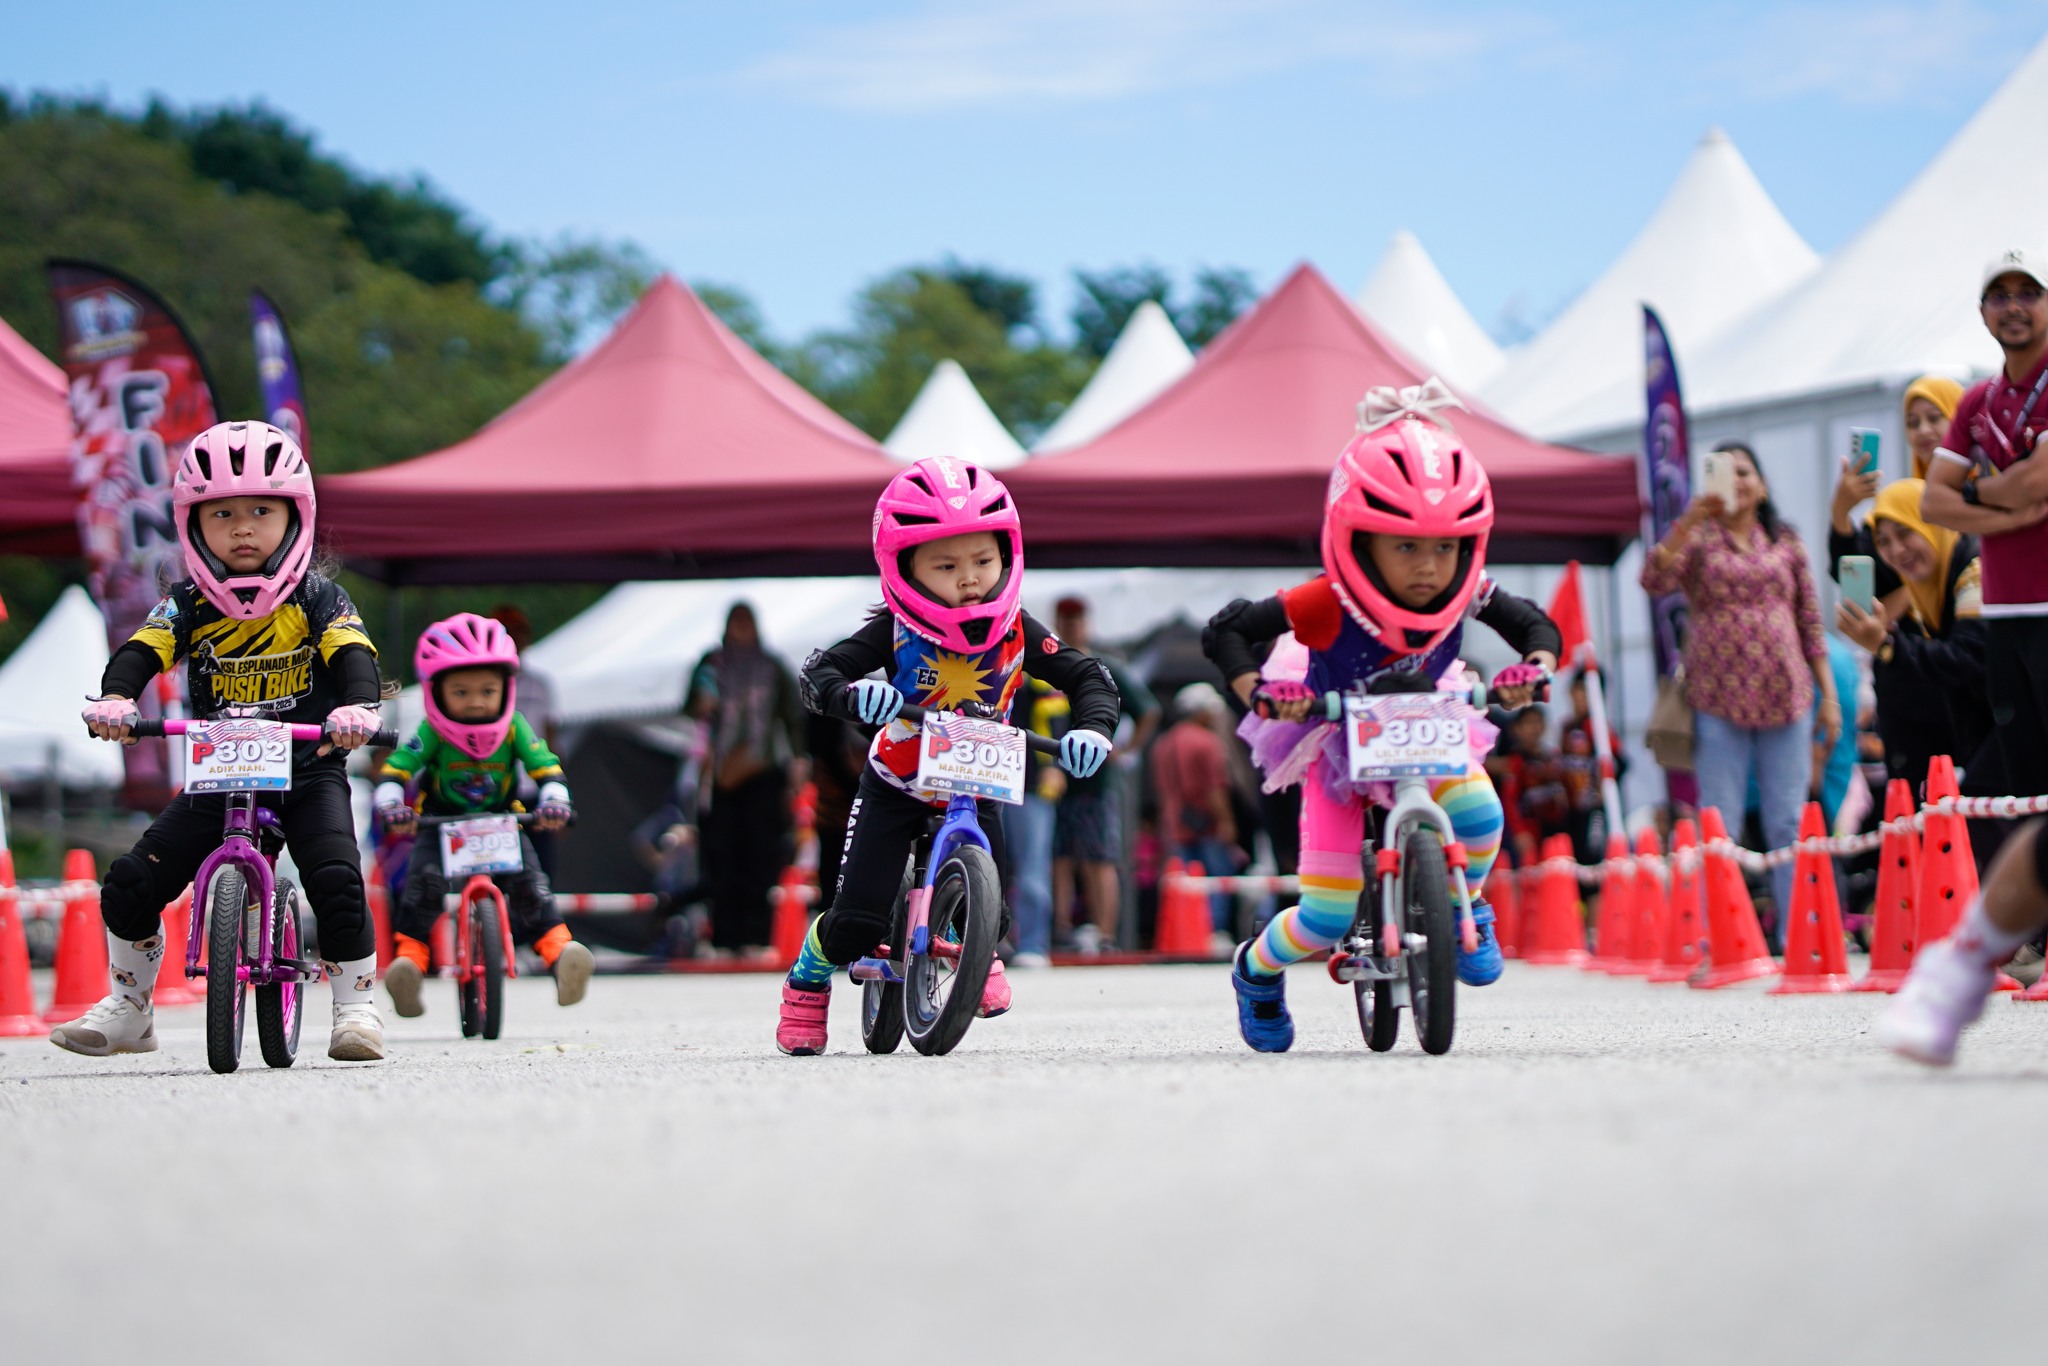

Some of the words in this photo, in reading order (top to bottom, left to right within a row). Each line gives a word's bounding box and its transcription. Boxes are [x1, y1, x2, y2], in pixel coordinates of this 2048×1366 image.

[238, 656, 290, 674] ESPLANADE
[212, 673, 263, 703] PUSH
[265, 663, 311, 700] BIKE
[276, 697, 293, 710] 2025
[1357, 719, 1465, 746] P308
[192, 740, 286, 764] P302
[928, 736, 1022, 771] P304
[209, 765, 235, 774] ADIK
[939, 763, 975, 775] MAIRA
[977, 769, 1010, 782] AKIRA
[451, 832, 517, 856] P303
